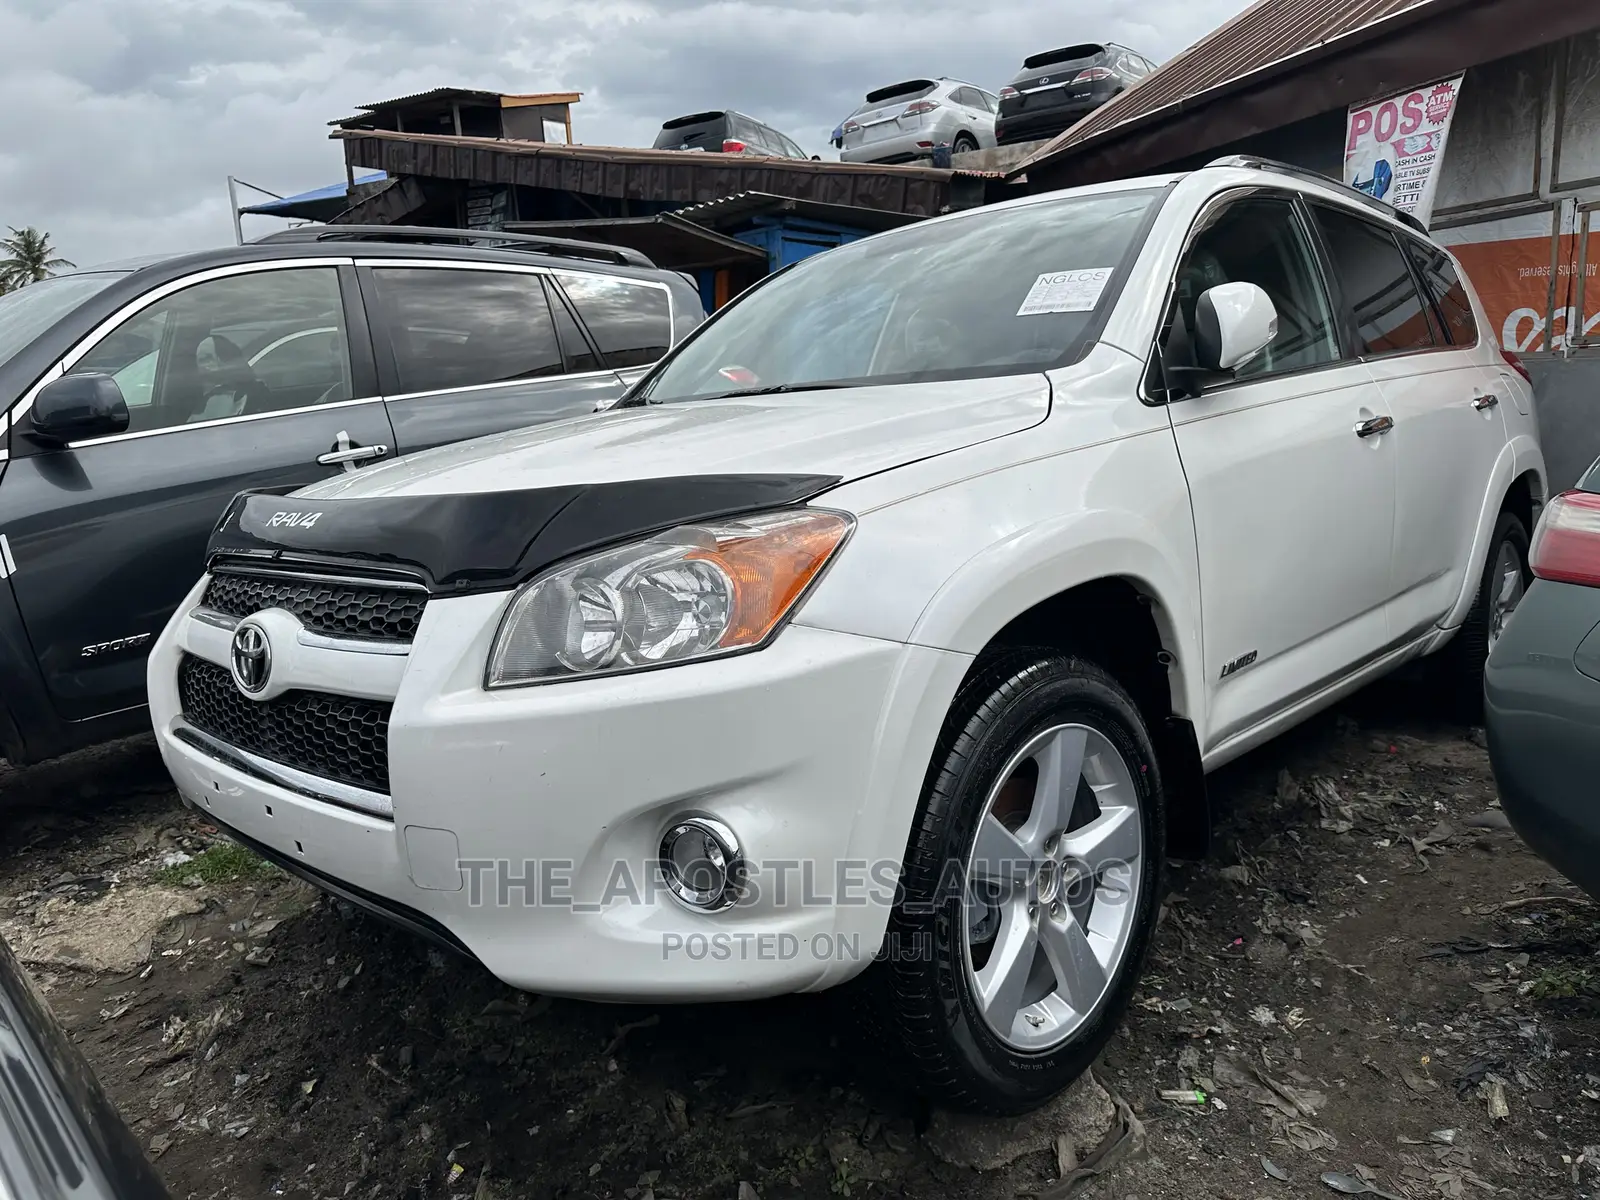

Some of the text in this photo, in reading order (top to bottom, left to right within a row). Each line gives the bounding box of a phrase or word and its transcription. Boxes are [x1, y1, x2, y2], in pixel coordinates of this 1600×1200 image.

[1428, 91, 1454, 107] ATM
[1347, 93, 1424, 150] POS
[1419, 153, 1436, 162] CASH
[1586, 263, 1598, 276] All
[1039, 272, 1106, 285] NGLOS
[265, 511, 323, 529] RAV4
[81, 632, 151, 656] SPORT
